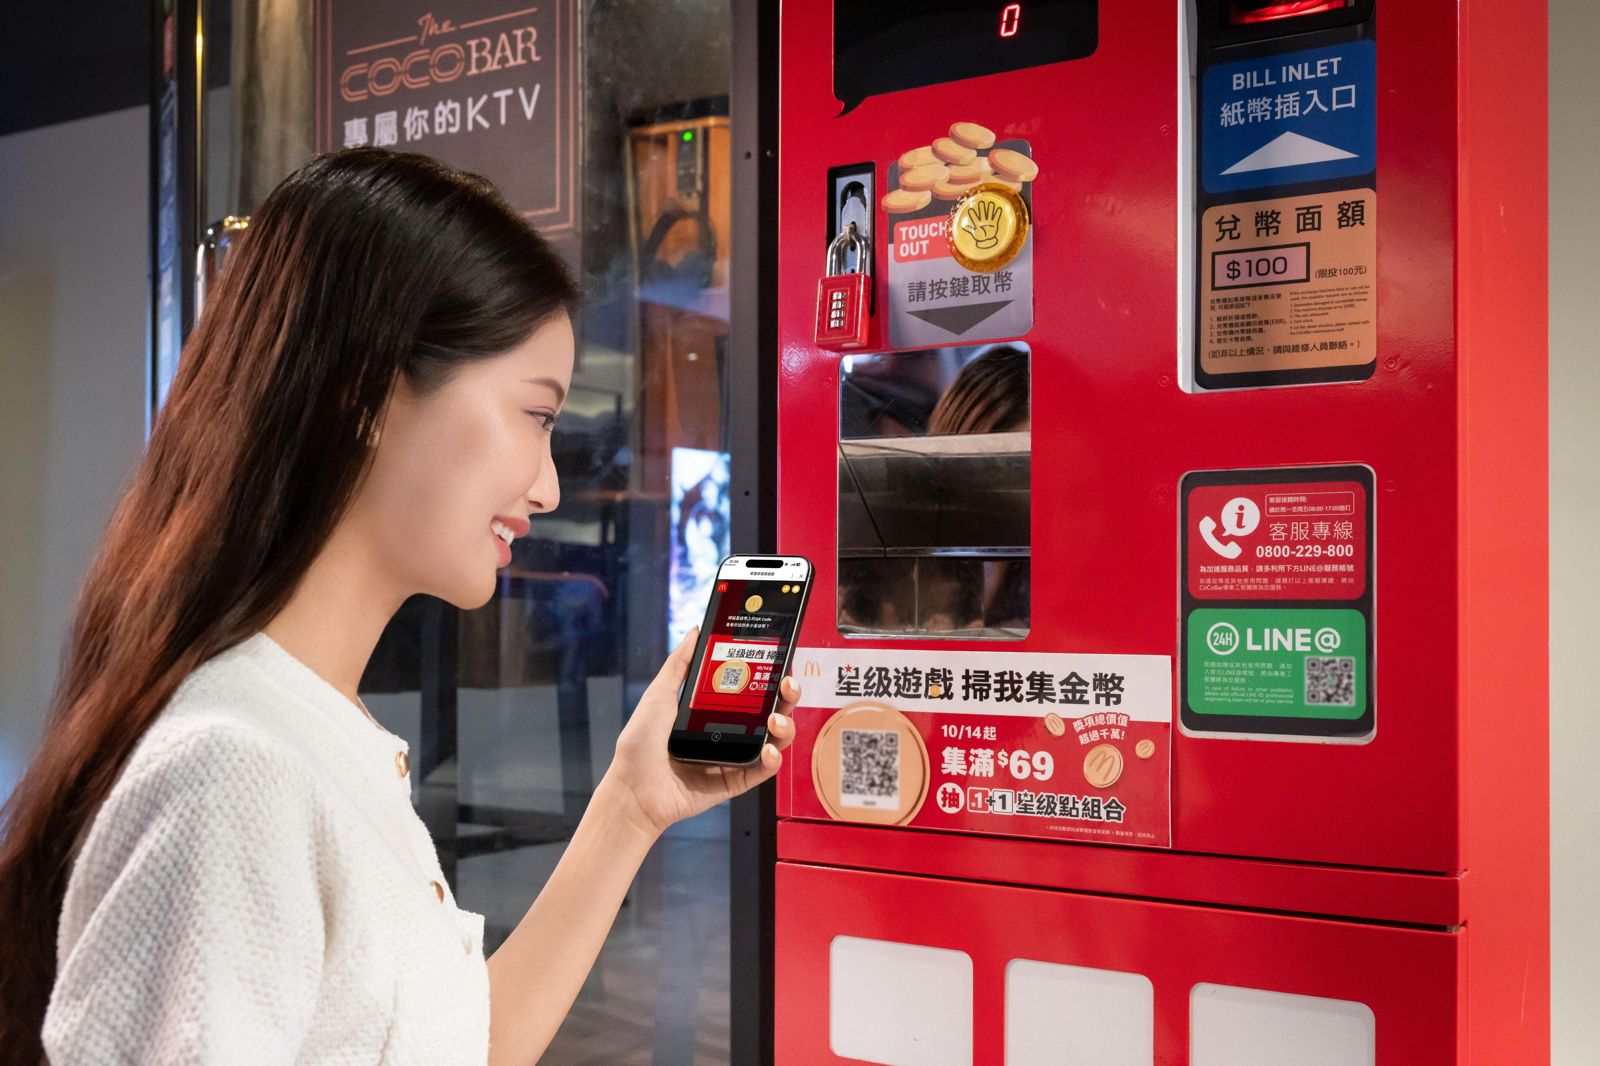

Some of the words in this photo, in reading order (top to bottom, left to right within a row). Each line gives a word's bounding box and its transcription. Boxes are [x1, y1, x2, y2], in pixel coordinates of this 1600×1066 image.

[418, 13, 455, 44] The
[1000, 4, 1020, 36] 0
[1232, 69, 1276, 91] BILL
[1282, 57, 1342, 83] INLET
[343, 84, 541, 149] 專屬你的KTV
[1220, 84, 1356, 128] 紙幣插入口
[899, 240, 929, 257] OUT
[1226, 256, 1288, 281] $100
[908, 271, 1014, 303] 請按鍵取幣
[1269, 520, 1354, 541] 客服專線
[1256, 544, 1354, 558] 0800-229-800
[1213, 632, 1233, 646] 24H
[1246, 628, 1341, 653] LINE@
[835, 664, 954, 699] 星級遊戲
[962, 668, 1125, 707] 掃我集金幣
[941, 725, 997, 741] 10/14起
